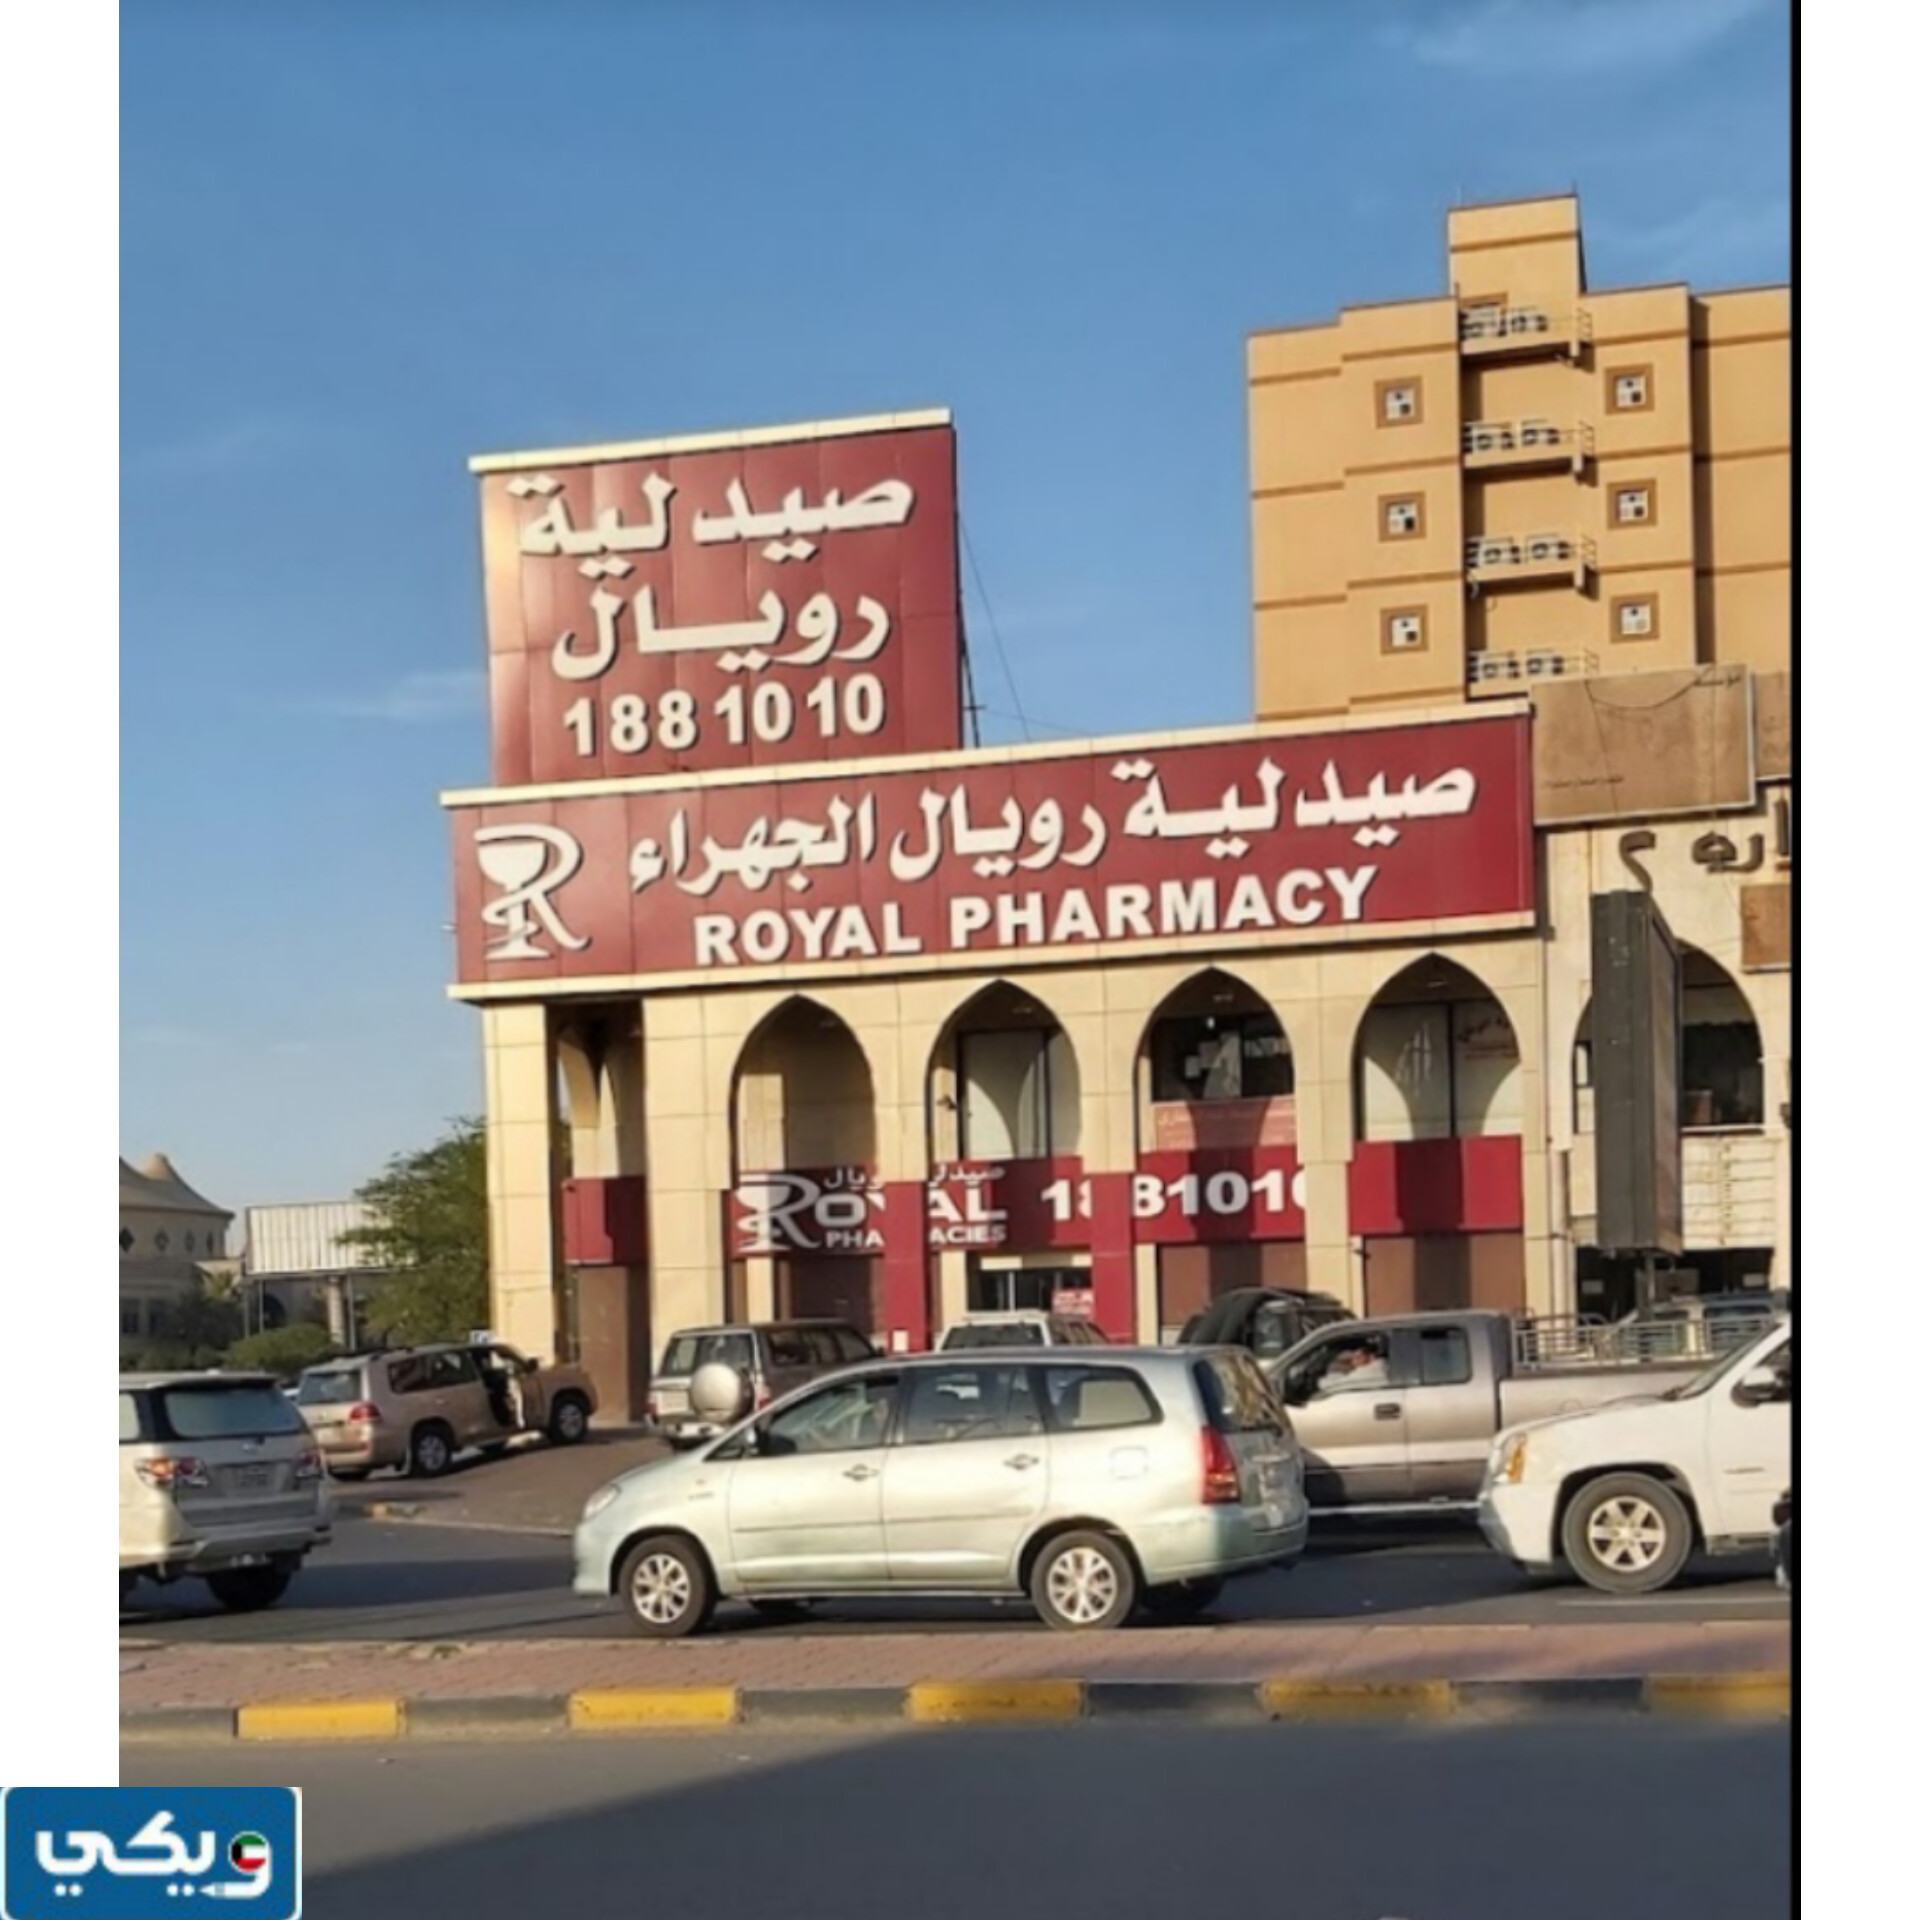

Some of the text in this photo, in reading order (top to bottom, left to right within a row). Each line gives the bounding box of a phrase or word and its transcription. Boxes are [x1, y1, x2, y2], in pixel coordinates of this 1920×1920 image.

[507, 472, 913, 579] صيدلية
[552, 584, 889, 680] رويال
[630, 756, 1476, 895] صيدلية رويال الجهراء
[694, 864, 1378, 967] ROYAL PHARMACY
